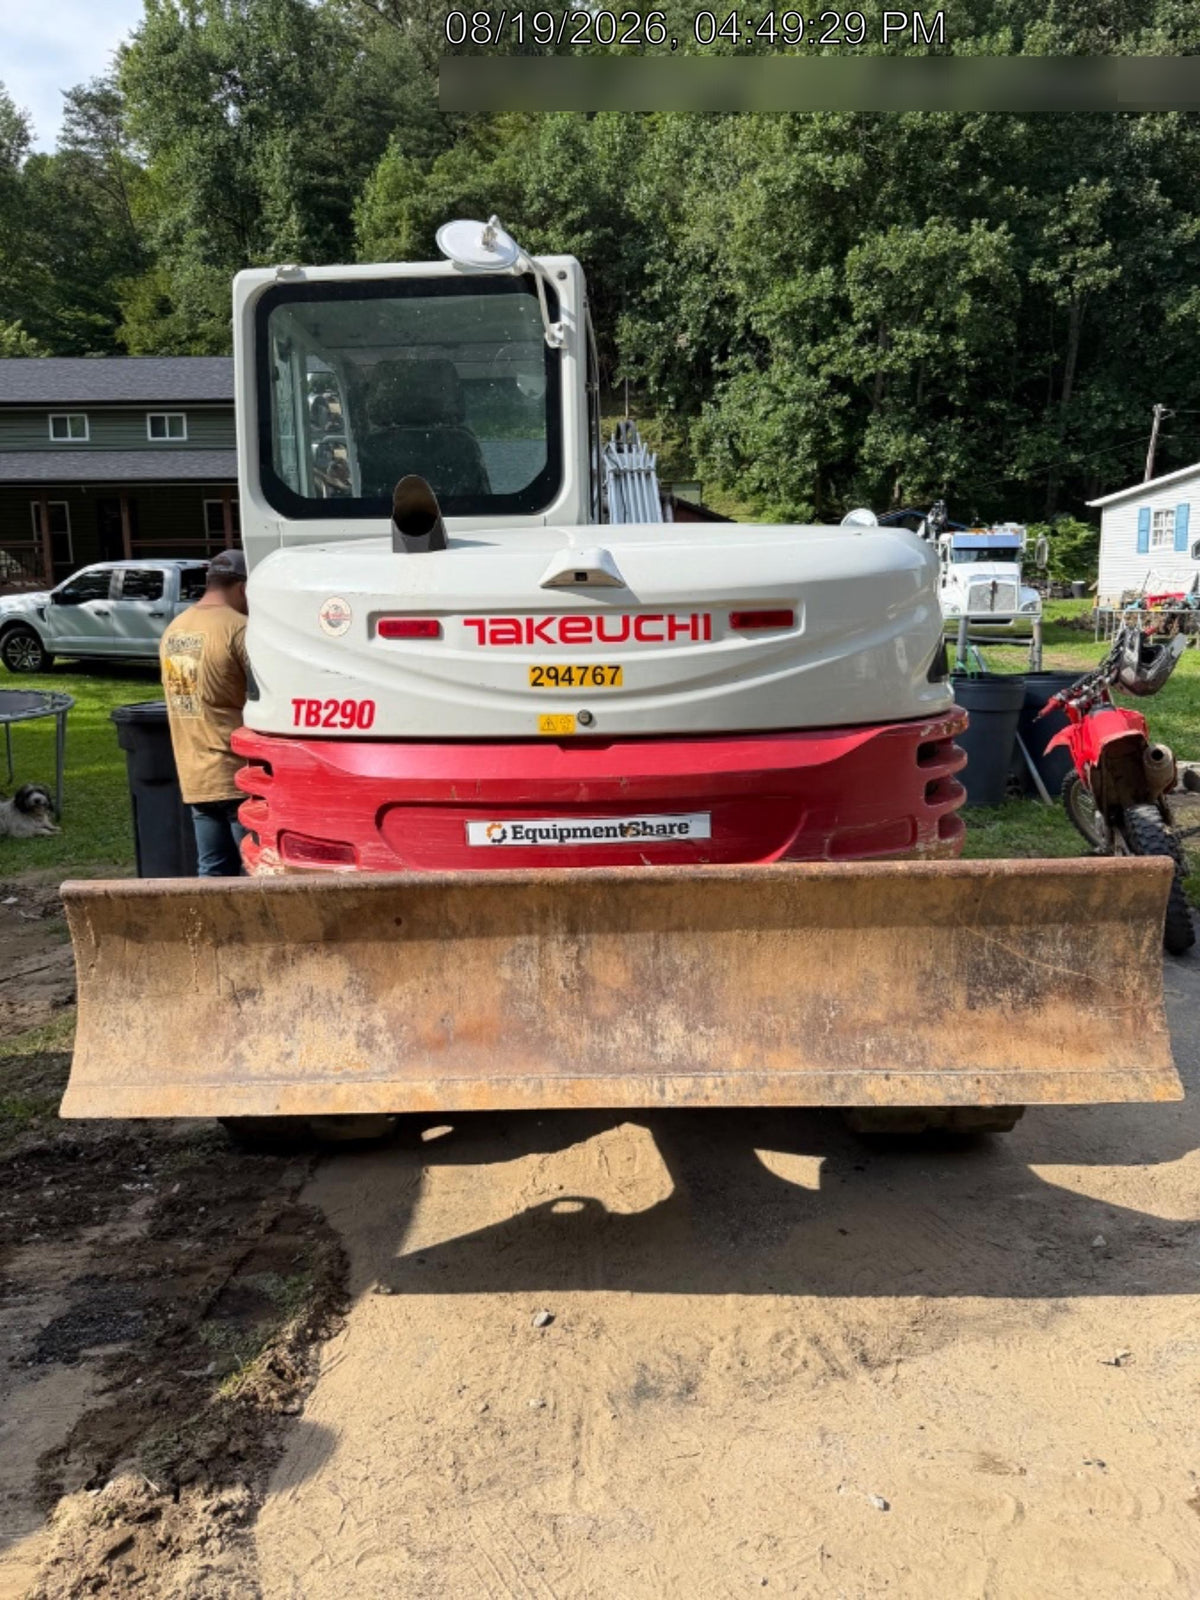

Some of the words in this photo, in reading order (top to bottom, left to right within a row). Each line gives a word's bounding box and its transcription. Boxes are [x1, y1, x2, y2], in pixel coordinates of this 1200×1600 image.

[530, 665, 621, 687] 294767
[291, 699, 376, 730] TB290
[511, 821, 690, 843] EquipmentShare
